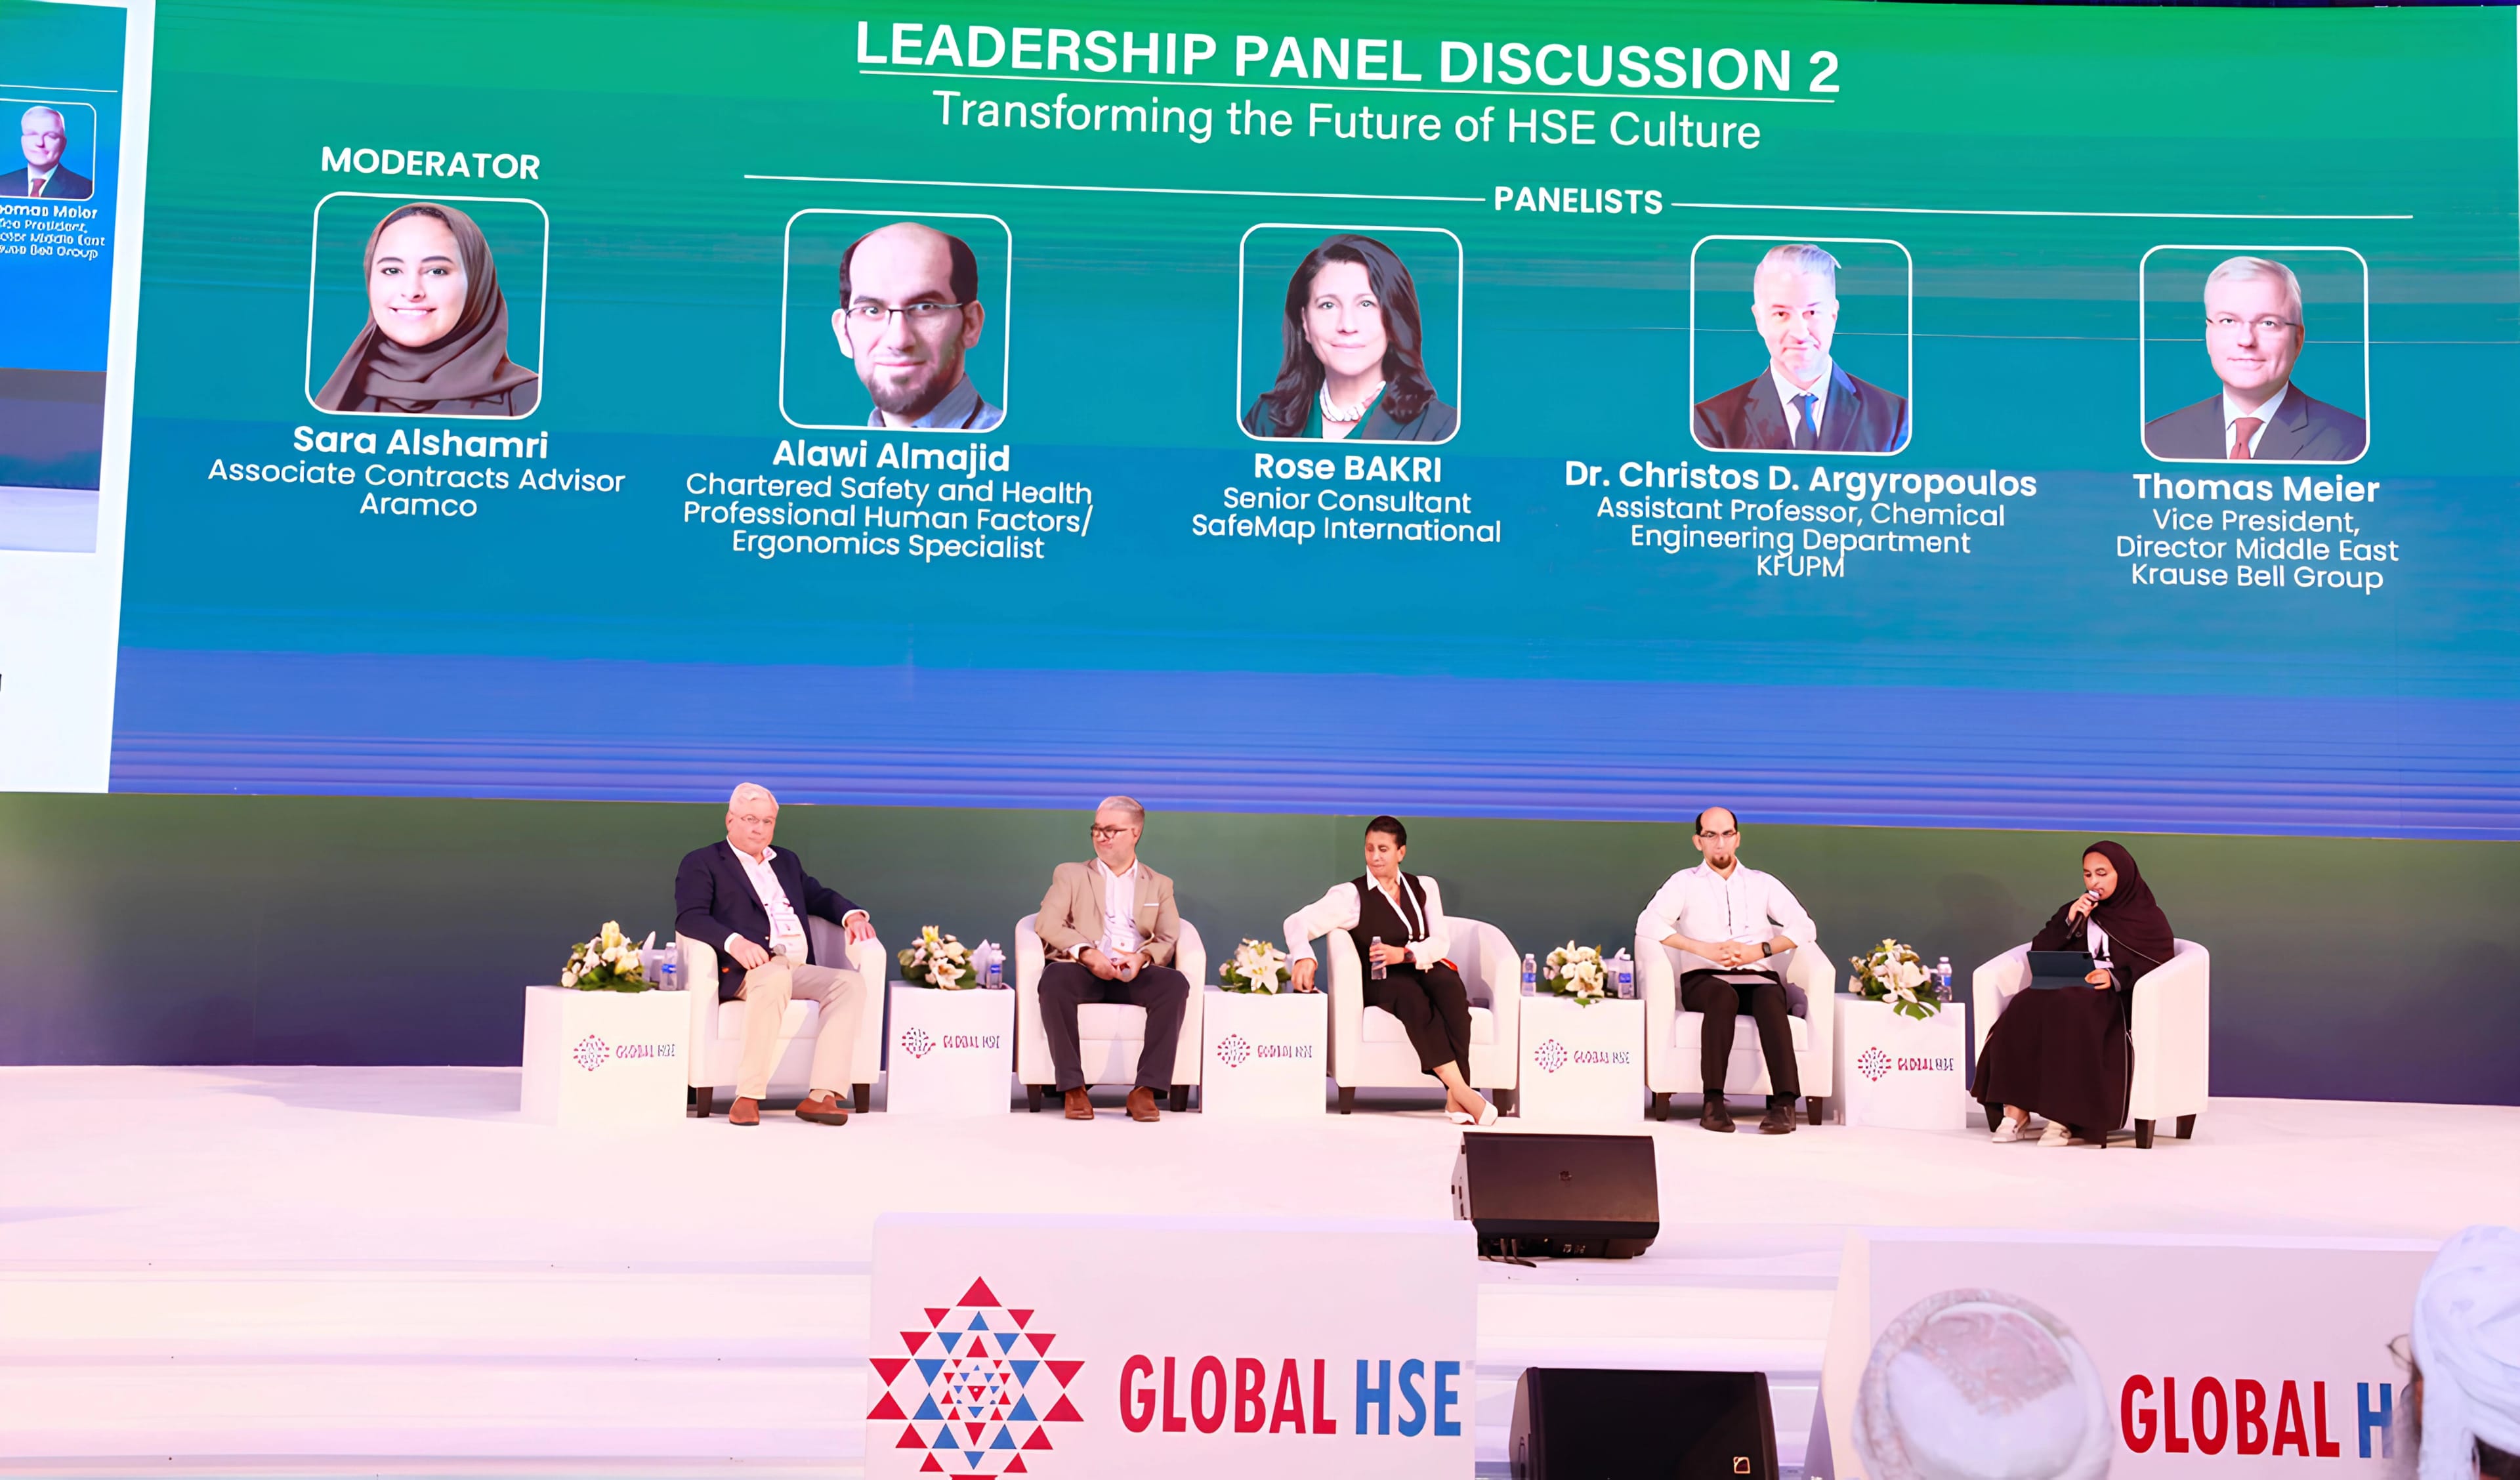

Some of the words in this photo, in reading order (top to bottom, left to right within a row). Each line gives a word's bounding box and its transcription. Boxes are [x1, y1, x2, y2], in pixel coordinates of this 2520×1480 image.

[857, 21, 1217, 75] LEADERSHIP
[1236, 35, 1422, 81] PANEL
[1440, 41, 1790, 91] DISCUSSION
[1809, 51, 1839, 93] 2
[933, 90, 1212, 144] Transforming
[1226, 99, 1293, 137] the
[1309, 102, 1441, 141] Future
[1455, 106, 1495, 142] of
[1509, 108, 1596, 144] HSE
[1610, 111, 1761, 150] Culture
[322, 146, 540, 180] MODERATOR
[1495, 186, 1663, 215] PANELISTS
[293, 425, 377, 454] Sara
[386, 428, 549, 459] Alshamri
[207, 459, 356, 485] Associate
[365, 464, 509, 489] Contracts
[518, 468, 626, 492] Advisor
[772, 439, 868, 468] Alawi
[876, 442, 1010, 479] Almajid
[1255, 453, 1335, 480] Rose
[1345, 455, 1441, 482] BAKRI
[686, 472, 831, 497] Chartered
[841, 476, 930, 508] Safety
[938, 480, 994, 502] and
[1002, 481, 1092, 505] Health
[1566, 460, 1610, 486] Dr.
[1619, 461, 1759, 490] Christos
[1769, 465, 1799, 491] D.
[1809, 466, 2037, 503] Argyropoulos
[2132, 472, 2273, 501] Thomas
[2283, 474, 2380, 503] Meier
[360, 492, 477, 517] Aramco
[1224, 486, 1311, 510] Senior
[1318, 489, 1471, 514] Consultant
[1597, 496, 1723, 520] Assistant
[1731, 498, 1863, 527] Professor,
[1870, 501, 2005, 526] Chemical
[684, 501, 855, 526] Professional
[865, 506, 967, 530] Human
[977, 504, 1093, 537] Factors/
[1192, 513, 1316, 545] SafeMap
[1324, 517, 1501, 543] International
[2152, 507, 2214, 531] Vice
[2222, 509, 2360, 537] President,
[733, 530, 900, 559] Ergonomics
[909, 534, 1045, 563] Specialist
[1631, 524, 1794, 558] Engineering
[1803, 528, 1971, 558] Department
[2116, 534, 2227, 559] Director
[2236, 536, 2330, 560] Middle
[2339, 539, 2399, 562] East
[1757, 555, 1845, 578] KFUPM
[2132, 562, 2229, 586] Krause
[2237, 564, 2285, 587] Bell
[2294, 566, 2384, 595] Group
[1120, 1354, 1337, 1435] GLOBAL
[1355, 1359, 1462, 1437] HSE
[2120, 1374, 2340, 1458] GLOBAL
